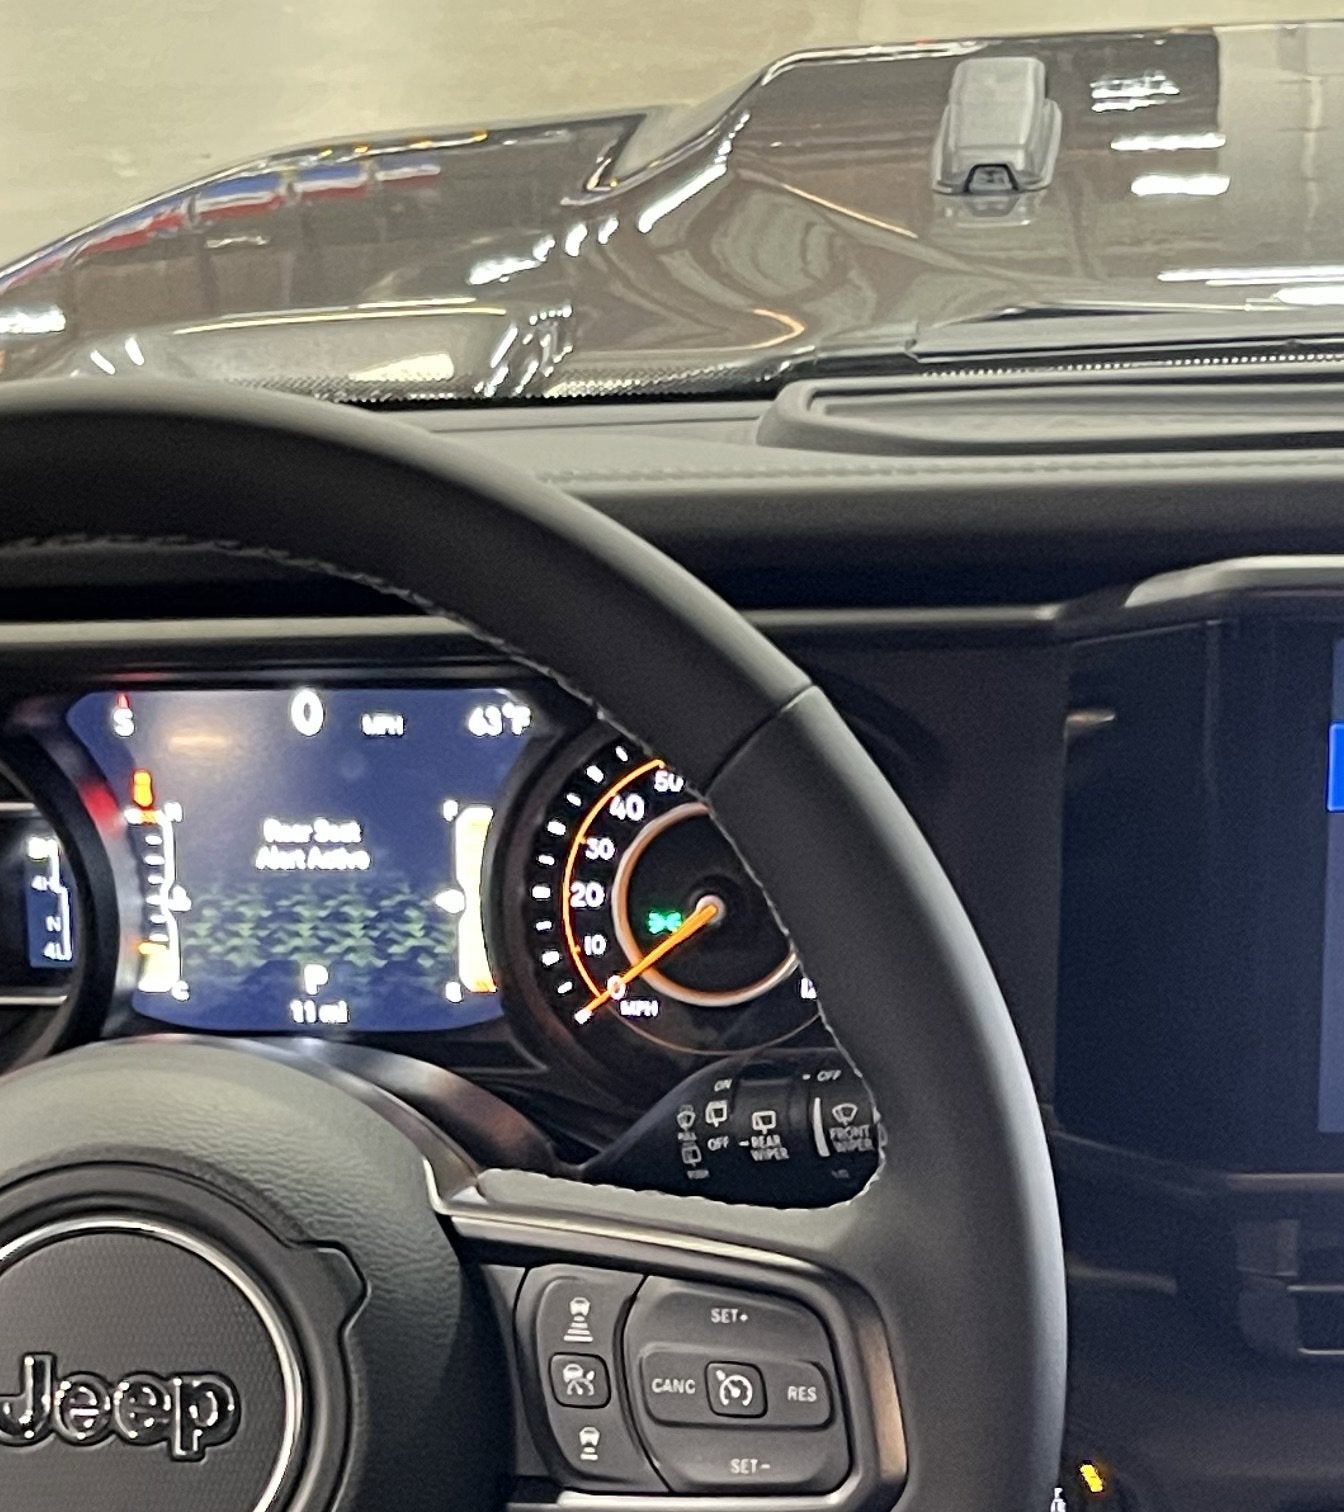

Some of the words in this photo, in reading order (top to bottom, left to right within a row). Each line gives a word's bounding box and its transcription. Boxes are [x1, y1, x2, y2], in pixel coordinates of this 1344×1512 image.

[113, 707, 135, 737] S
[290, 689, 324, 736] 0
[361, 713, 404, 735] MPH
[609, 796, 646, 820] 40
[584, 838, 615, 860] 30
[570, 882, 604, 907] 20
[584, 936, 606, 956] 10
[305, 964, 328, 995] P
[290, 1001, 317, 1024] 11
[620, 1000, 657, 1017] MPH
[714, 1079, 733, 1092] ON
[817, 1070, 841, 1081] OFF
[707, 1136, 729, 1151] OFF
[650, 1377, 696, 1395] CANC
[787, 1385, 817, 1402] RES
